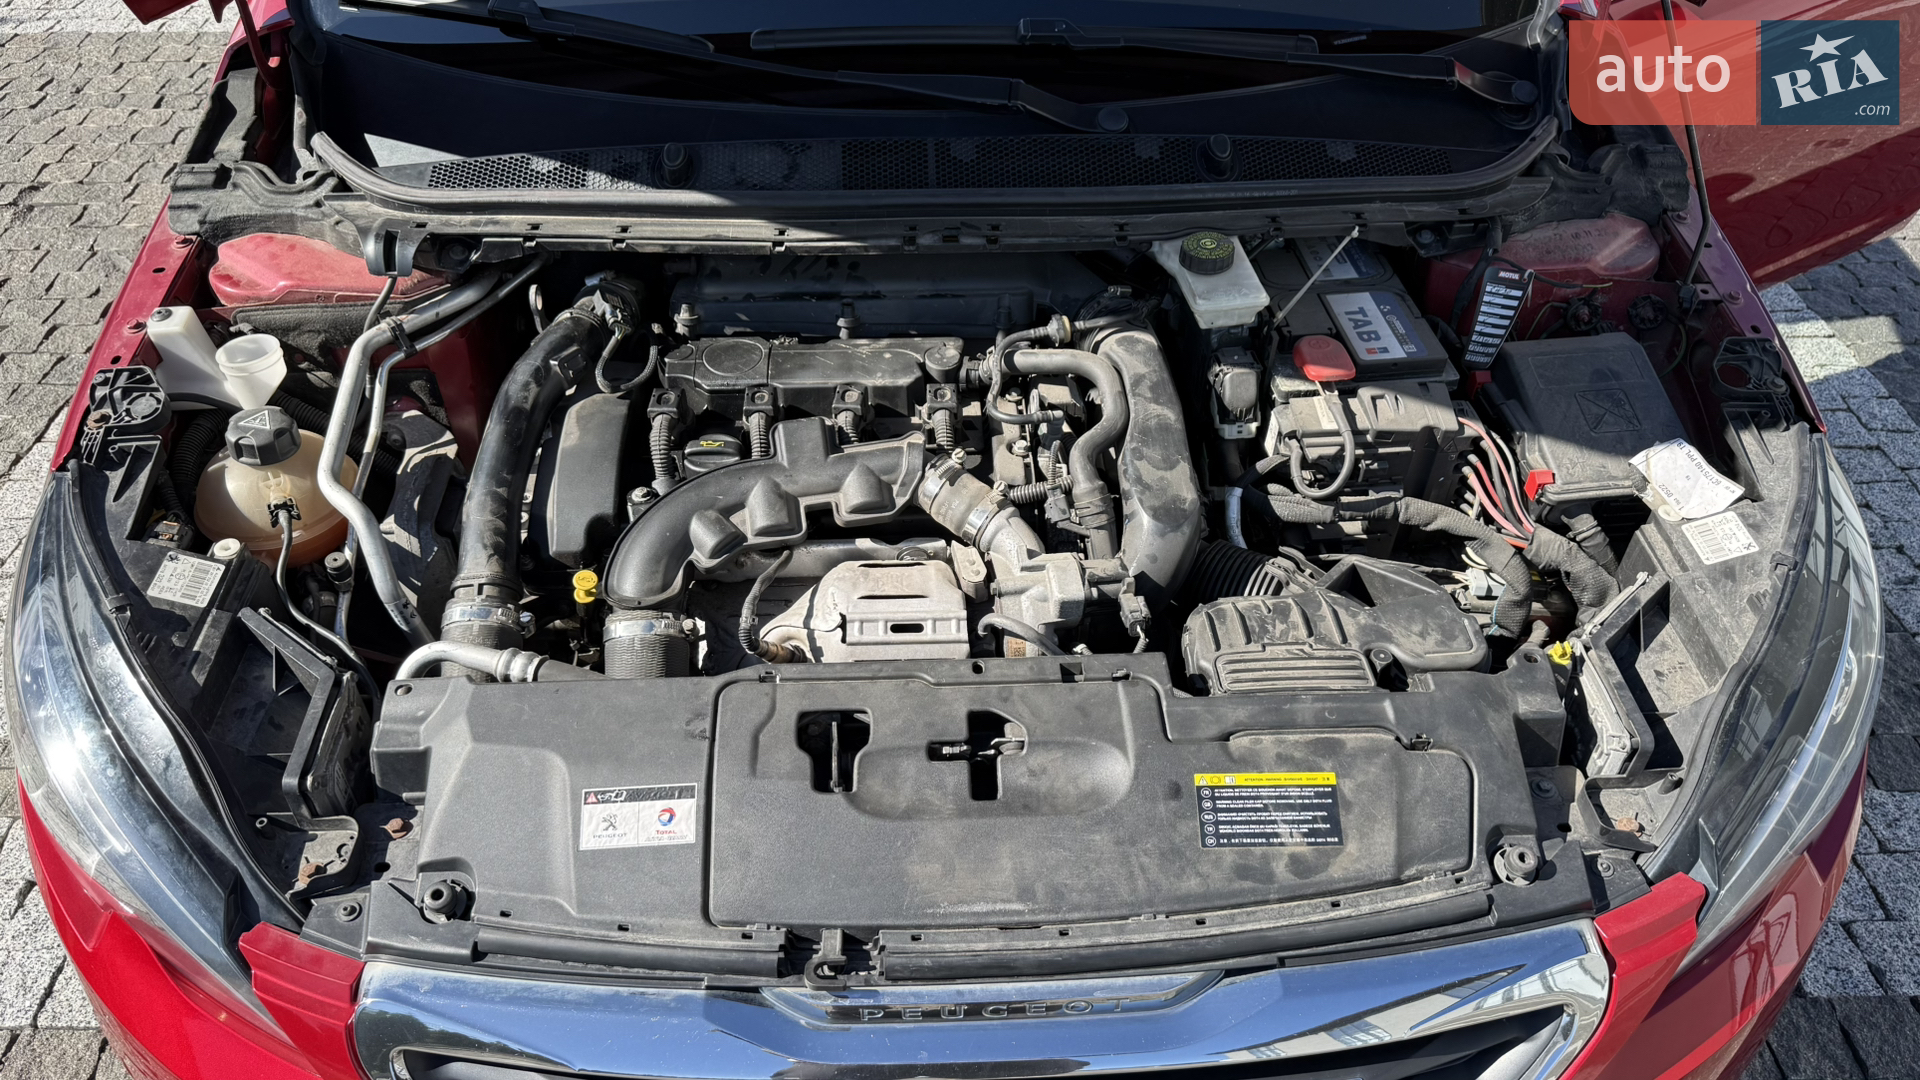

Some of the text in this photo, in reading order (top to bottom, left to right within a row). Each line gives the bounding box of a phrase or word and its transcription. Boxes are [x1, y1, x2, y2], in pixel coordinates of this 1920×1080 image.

[1499, 271, 1520, 280] MOTUL
[1344, 306, 1382, 343] TAB
[1686, 449, 1698, 463] PPL
[859, 998, 1130, 1020] PEUGEOT
